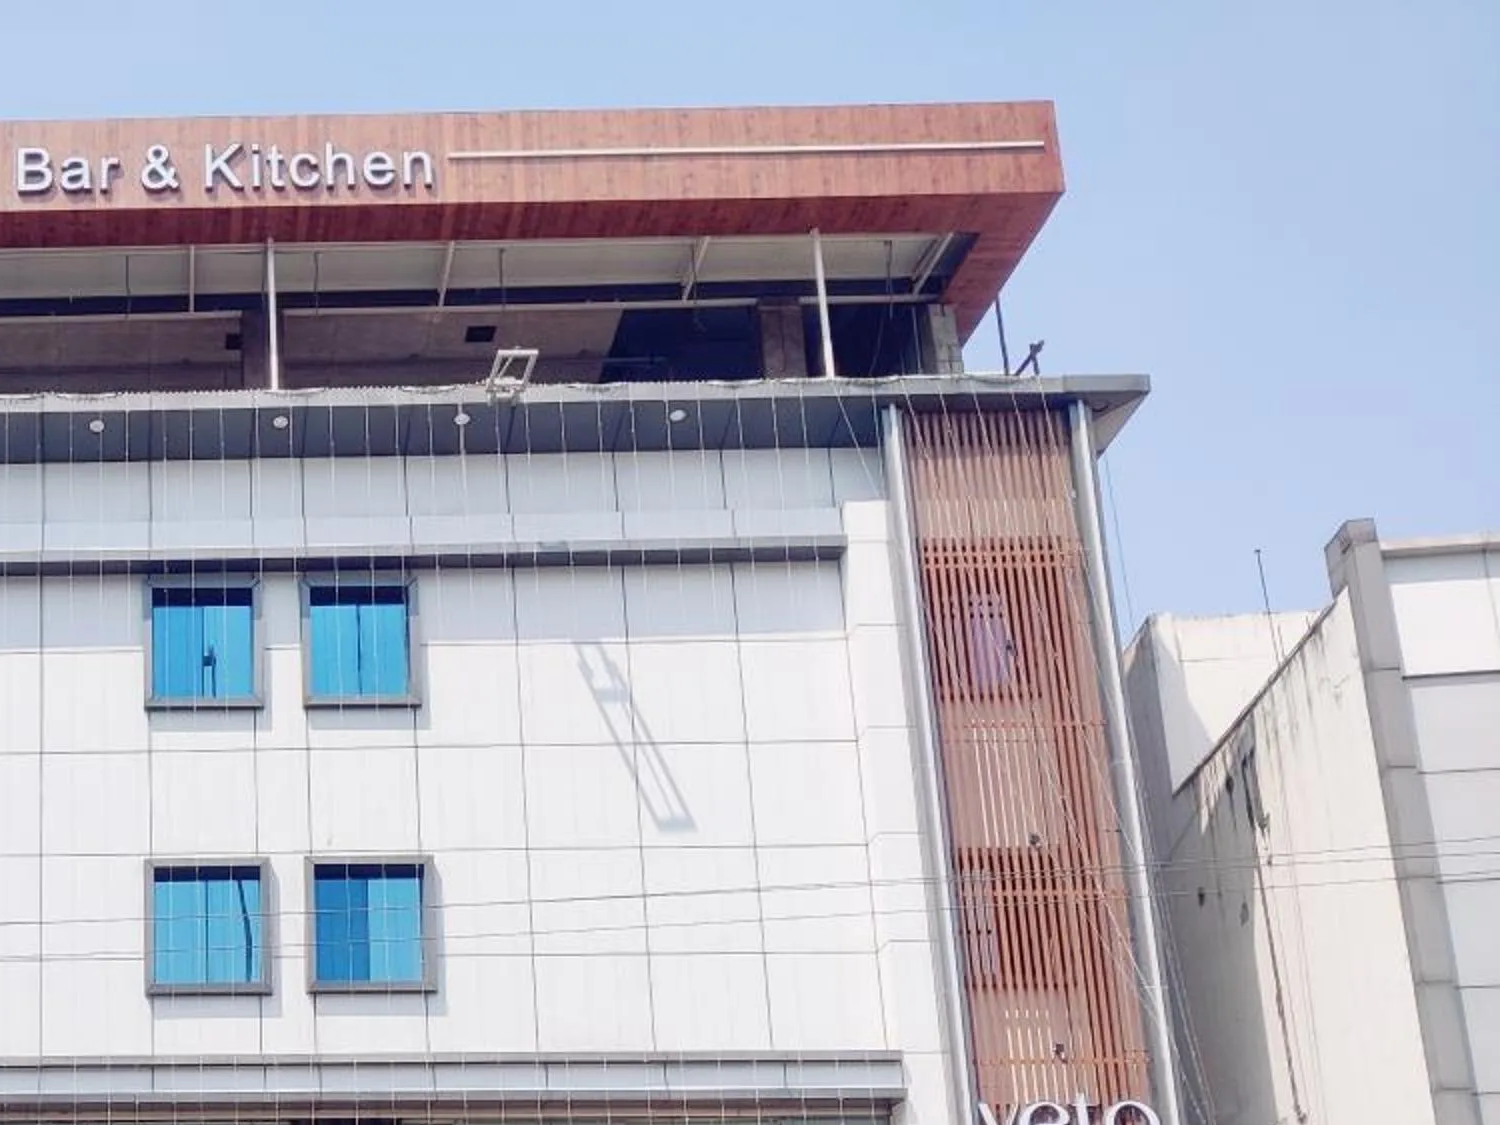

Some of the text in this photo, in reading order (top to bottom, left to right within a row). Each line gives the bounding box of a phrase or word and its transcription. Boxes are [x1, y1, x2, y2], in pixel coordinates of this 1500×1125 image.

[15, 147, 118, 193] Bar
[141, 145, 181, 190] &
[204, 140, 434, 191] Kitchen
